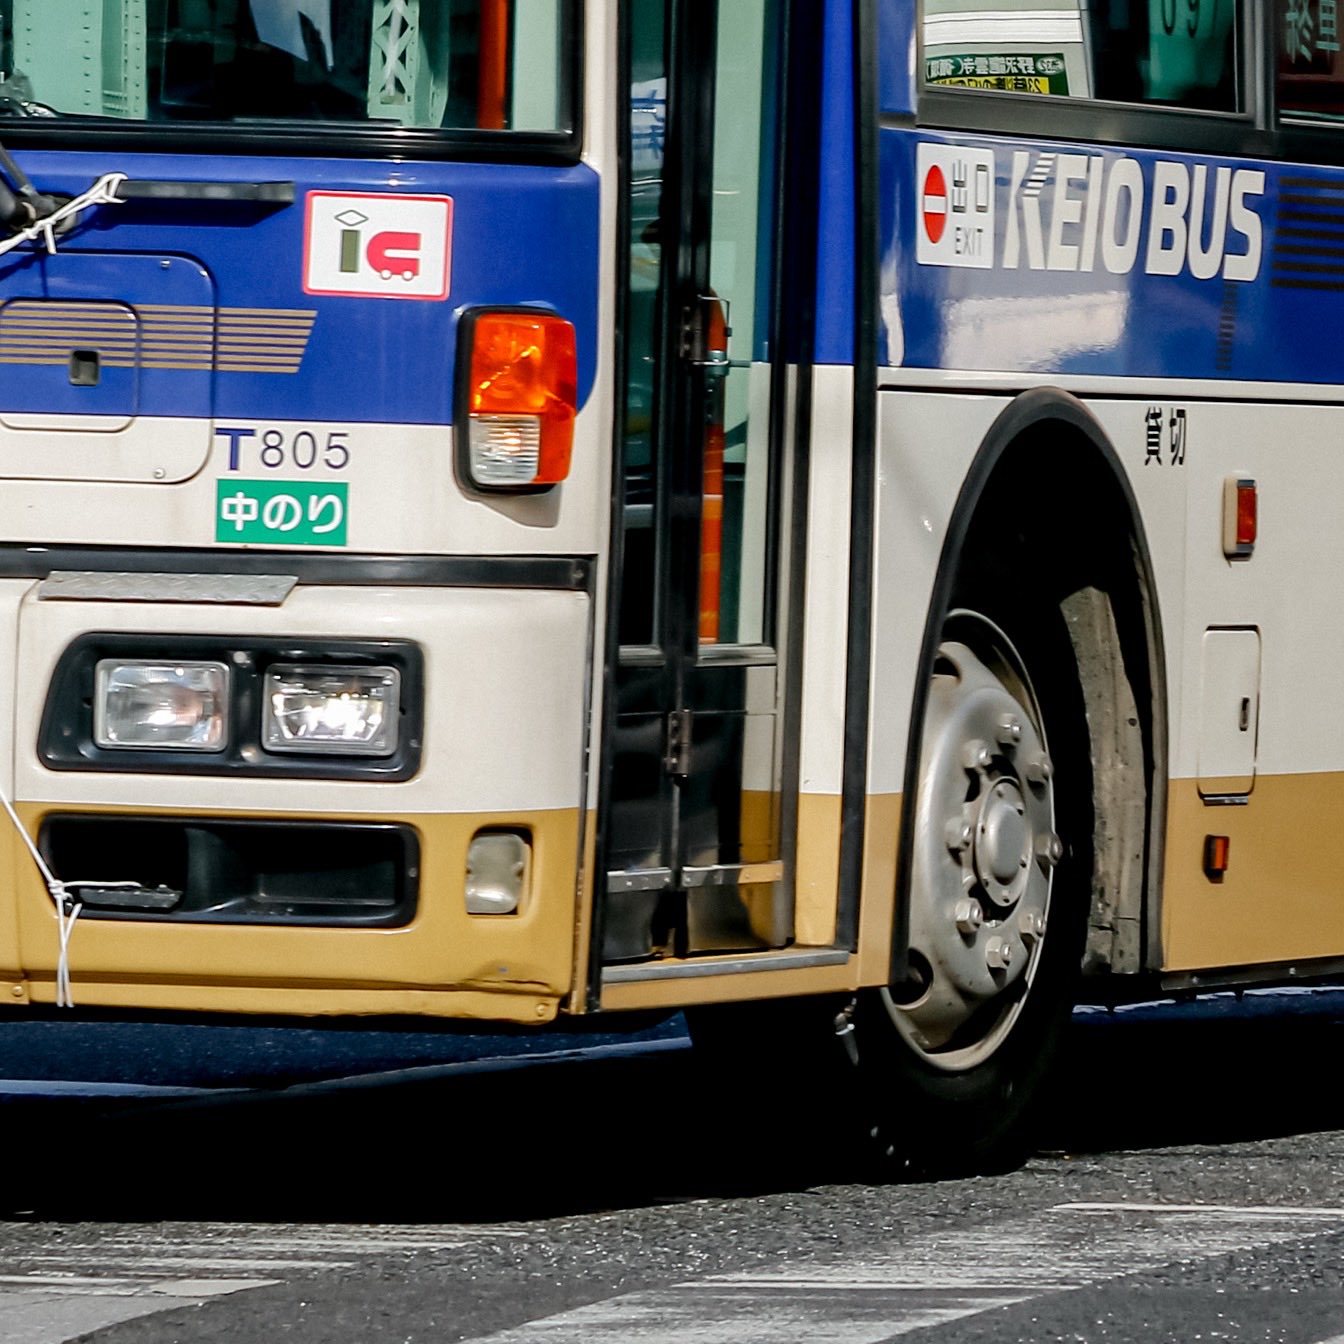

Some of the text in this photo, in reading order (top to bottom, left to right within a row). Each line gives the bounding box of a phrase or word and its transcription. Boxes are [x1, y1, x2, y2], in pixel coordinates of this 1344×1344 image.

[952, 159, 990, 213] 出口
[955, 226, 983, 256] EXIT
[1002, 151, 1266, 282] KEIO BUS
[215, 427, 350, 471] T805
[1144, 406, 1187, 466] 貸切
[221, 492, 344, 533] 中のり
